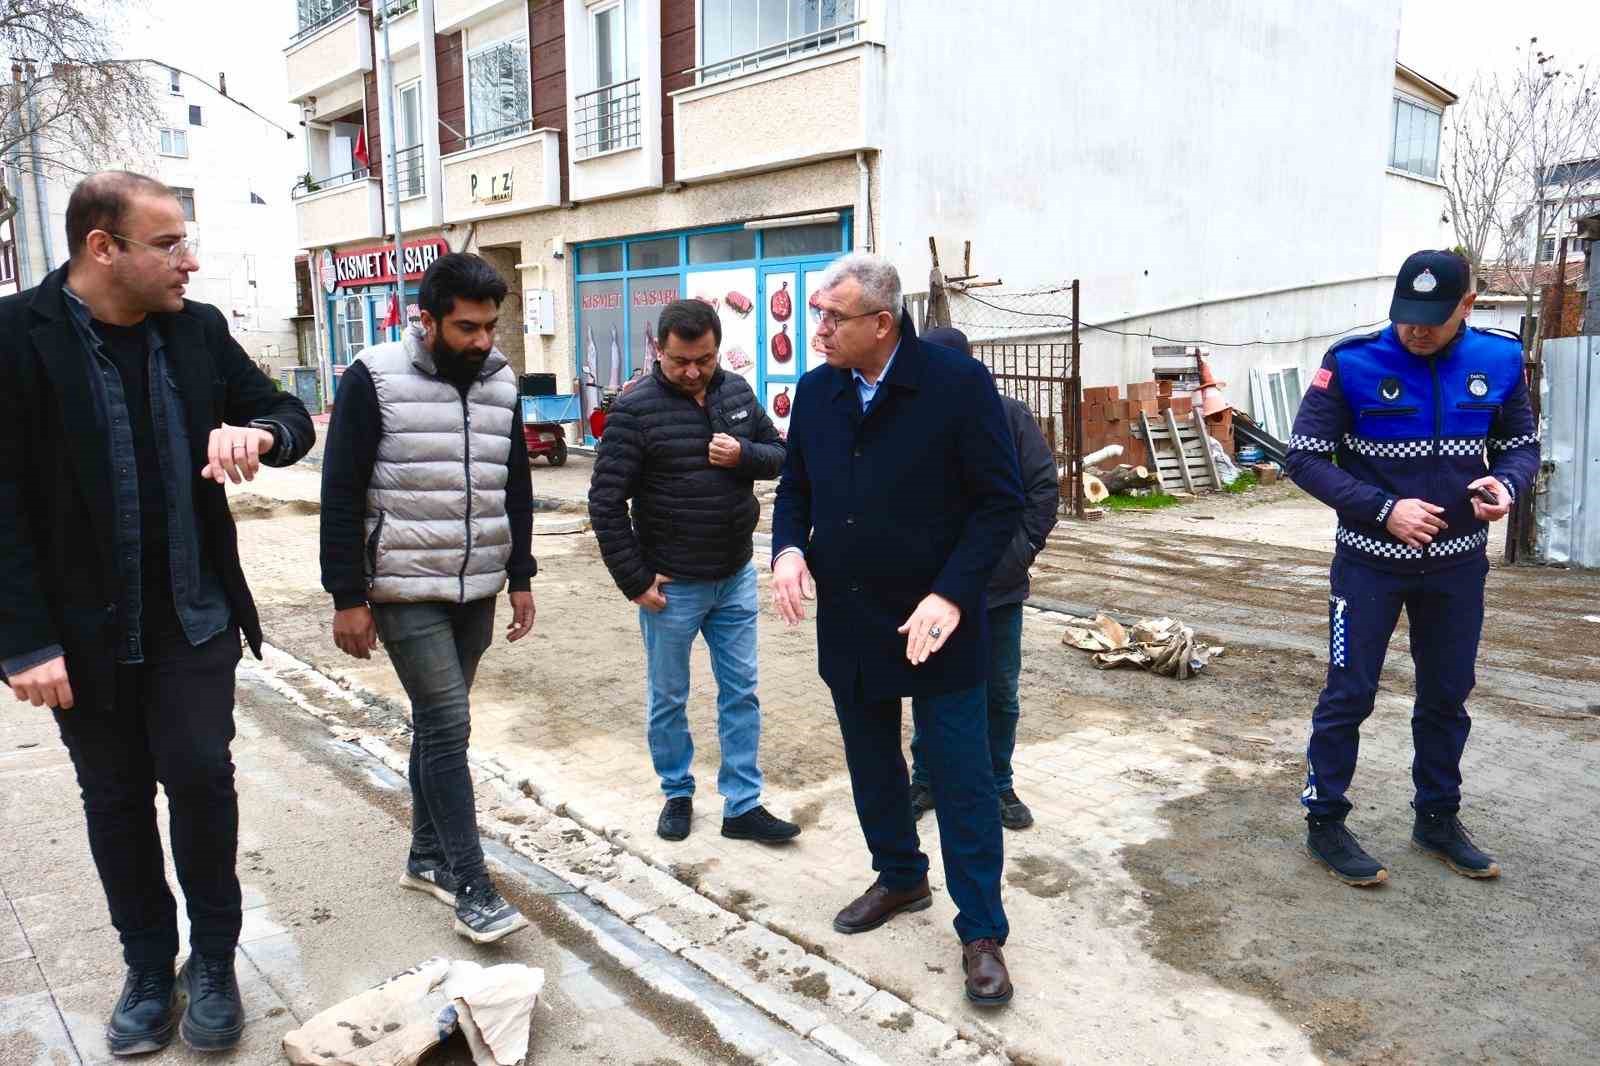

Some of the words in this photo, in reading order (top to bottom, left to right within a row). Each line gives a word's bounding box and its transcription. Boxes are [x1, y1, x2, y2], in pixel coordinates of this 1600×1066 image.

[336, 251, 382, 281] KISMET
[387, 245, 439, 275] KSABI
[583, 293, 622, 309] KISMET
[1376, 499, 1393, 522] ZABITA
